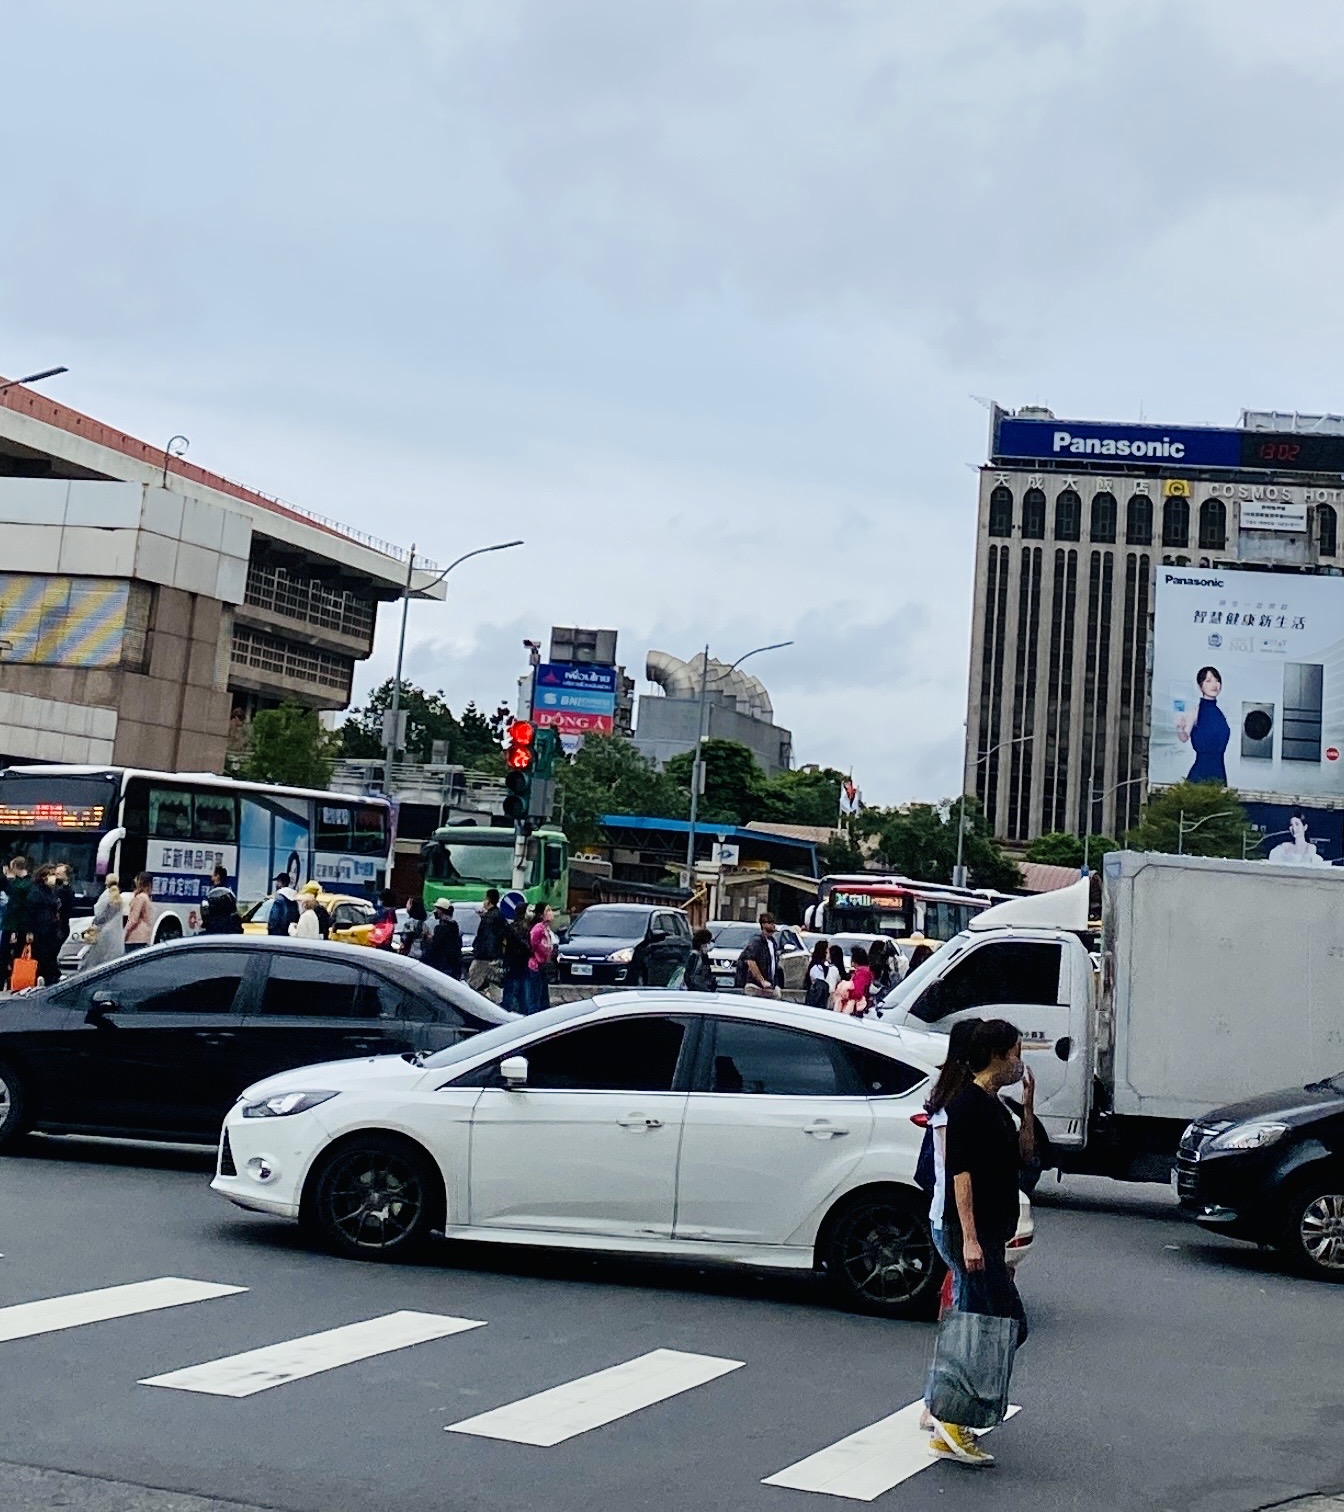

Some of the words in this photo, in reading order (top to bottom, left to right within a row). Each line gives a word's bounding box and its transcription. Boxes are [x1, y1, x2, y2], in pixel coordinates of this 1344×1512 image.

[1053, 431, 1185, 459] Panasonic
[994, 473, 1150, 495] 天成大飯店
[1209, 484, 1292, 501] COSMOS
[1165, 574, 1225, 588] Panasonic
